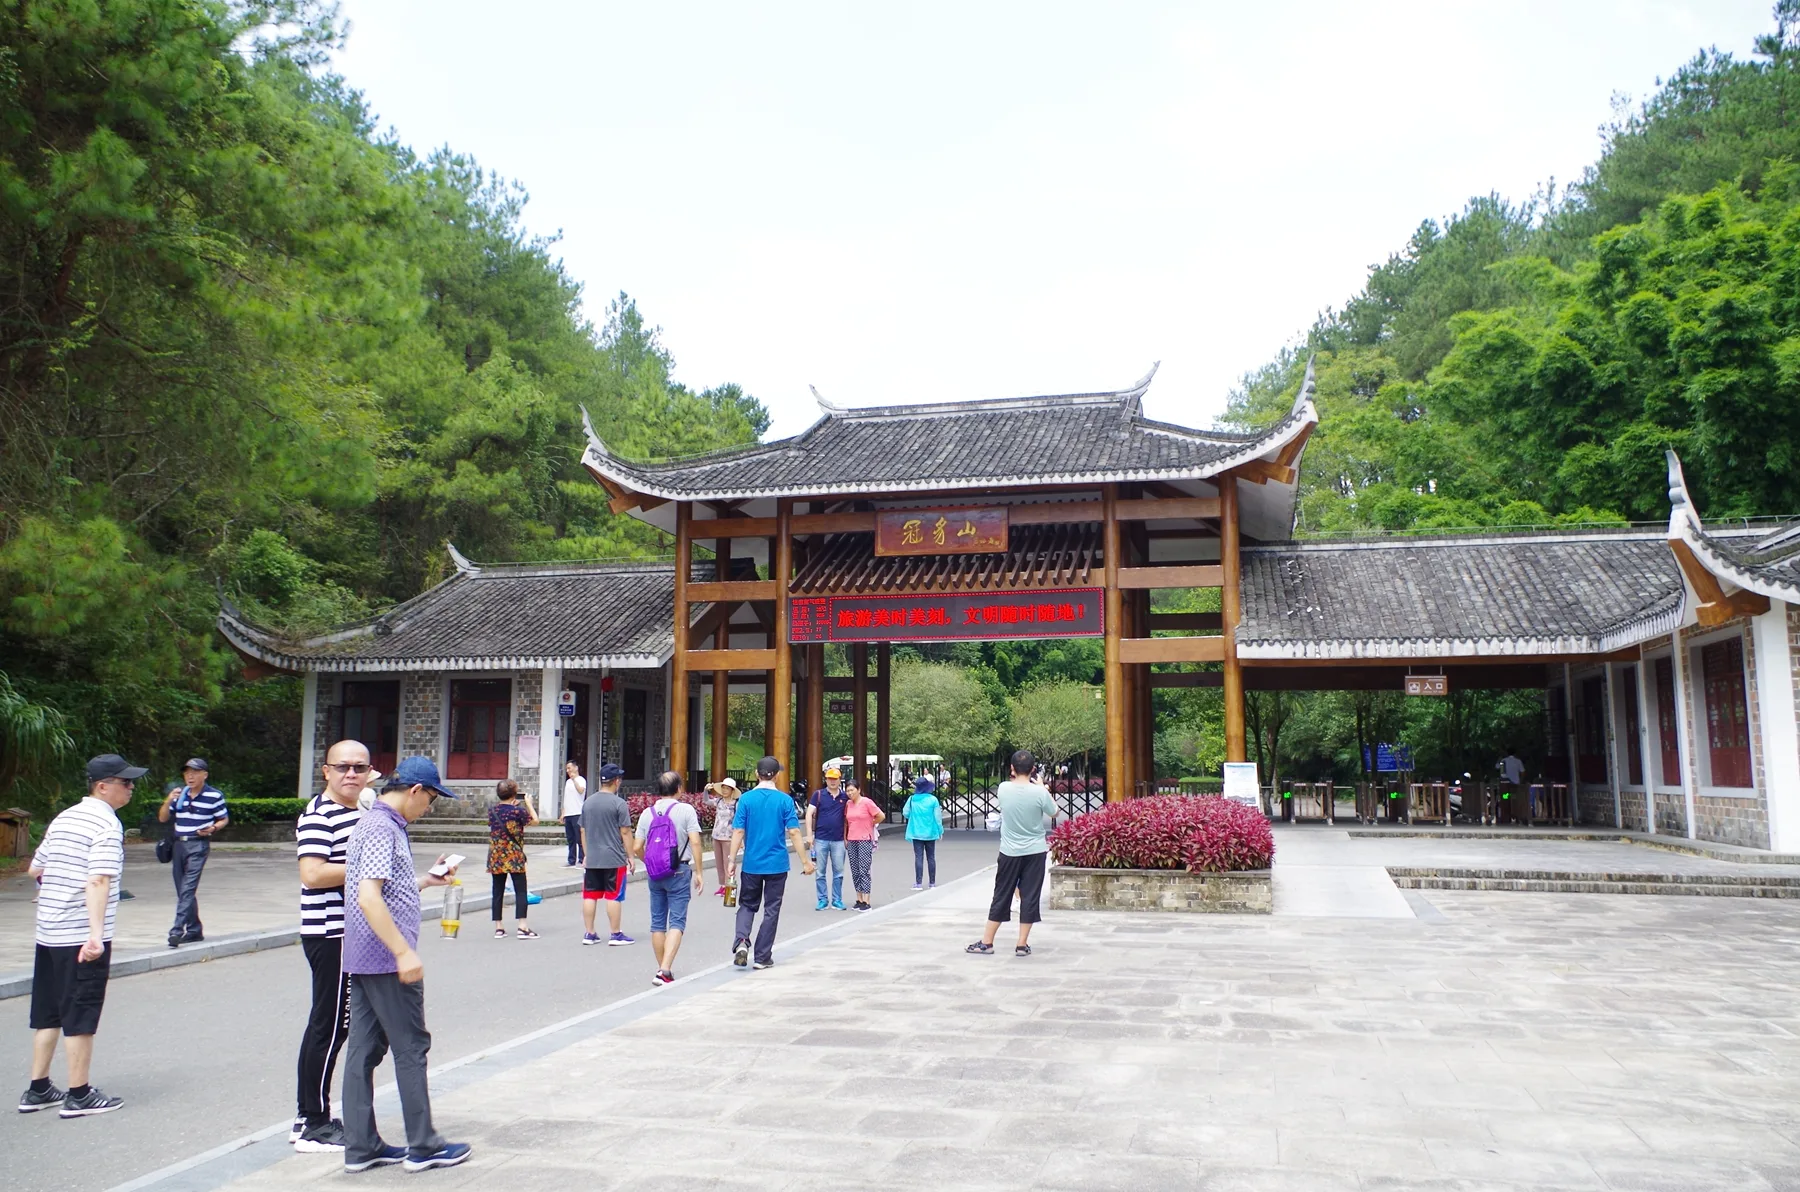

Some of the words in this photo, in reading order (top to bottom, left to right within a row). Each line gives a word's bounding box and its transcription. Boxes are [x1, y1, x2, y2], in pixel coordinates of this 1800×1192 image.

[901, 516, 977, 545] 冠豸山
[836, 603, 1086, 628] 旅游美时美刻，文明随时随地！
[1424, 682, 1443, 690] 入口
